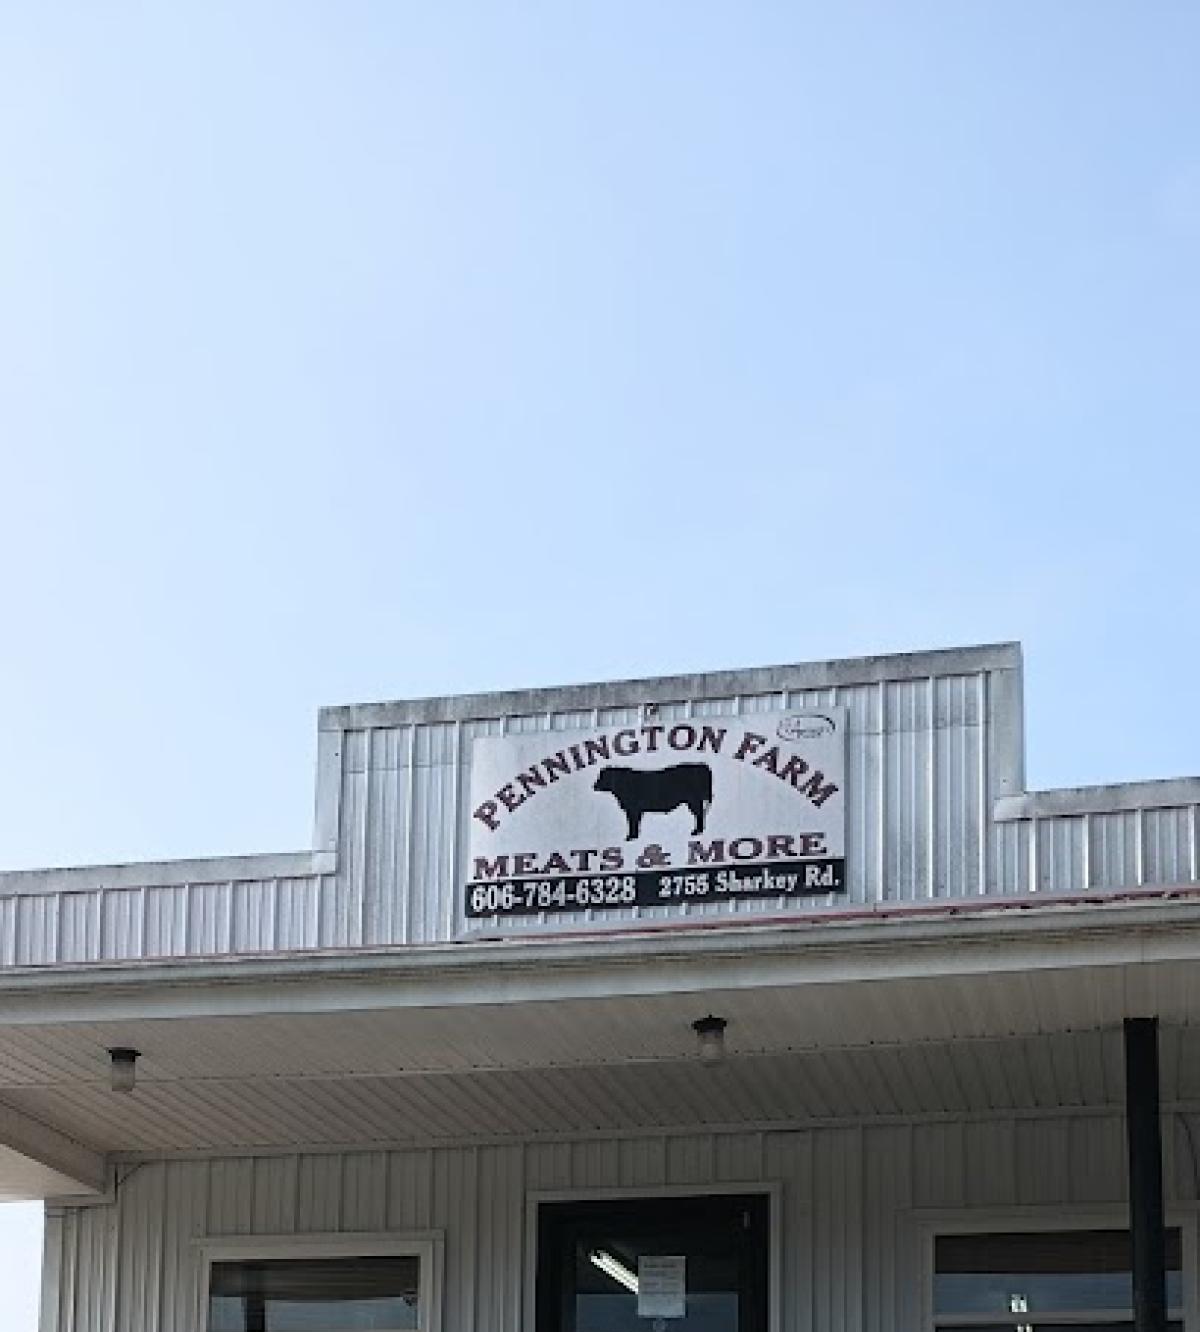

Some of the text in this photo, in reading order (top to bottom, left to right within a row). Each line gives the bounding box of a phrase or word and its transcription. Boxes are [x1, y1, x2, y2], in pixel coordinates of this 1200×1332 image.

[473, 723, 839, 831] PENNINGTON FARM
[474, 832, 827, 880] MEATS & MORE
[472, 864, 841, 910] 606-784-6328 2755 Sharkey Rd.
